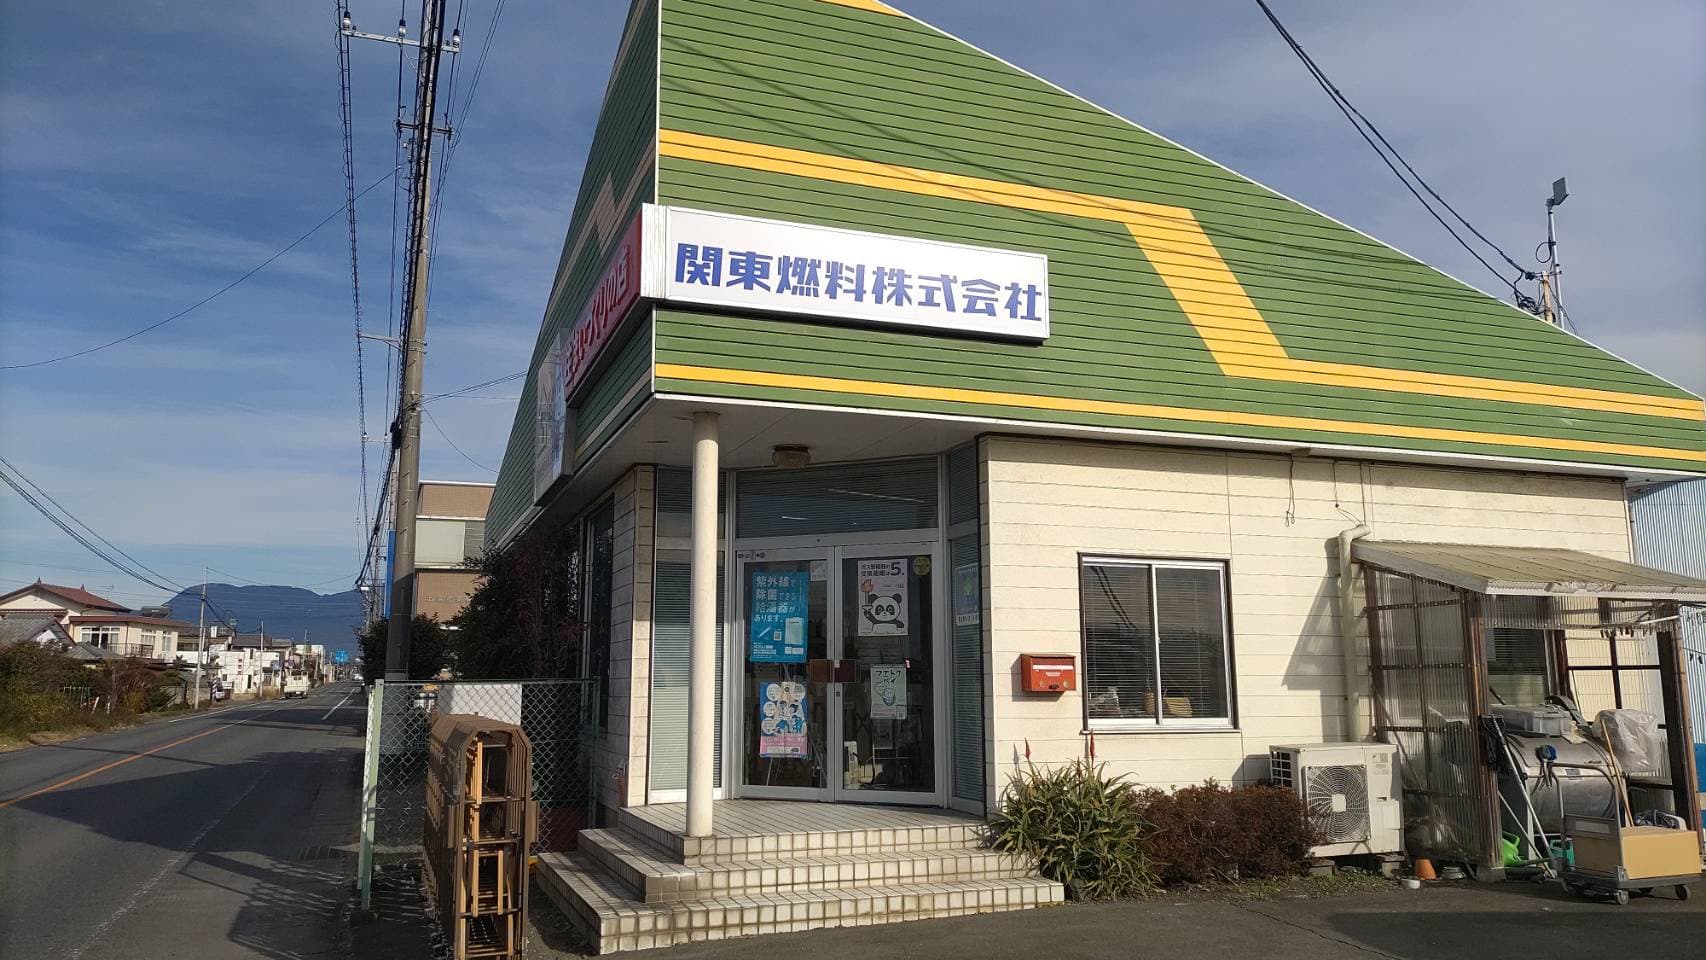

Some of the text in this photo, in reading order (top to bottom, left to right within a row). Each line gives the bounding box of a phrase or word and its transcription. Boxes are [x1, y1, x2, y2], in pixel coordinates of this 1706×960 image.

[675, 243, 1042, 322] 関東燃料株式会社
